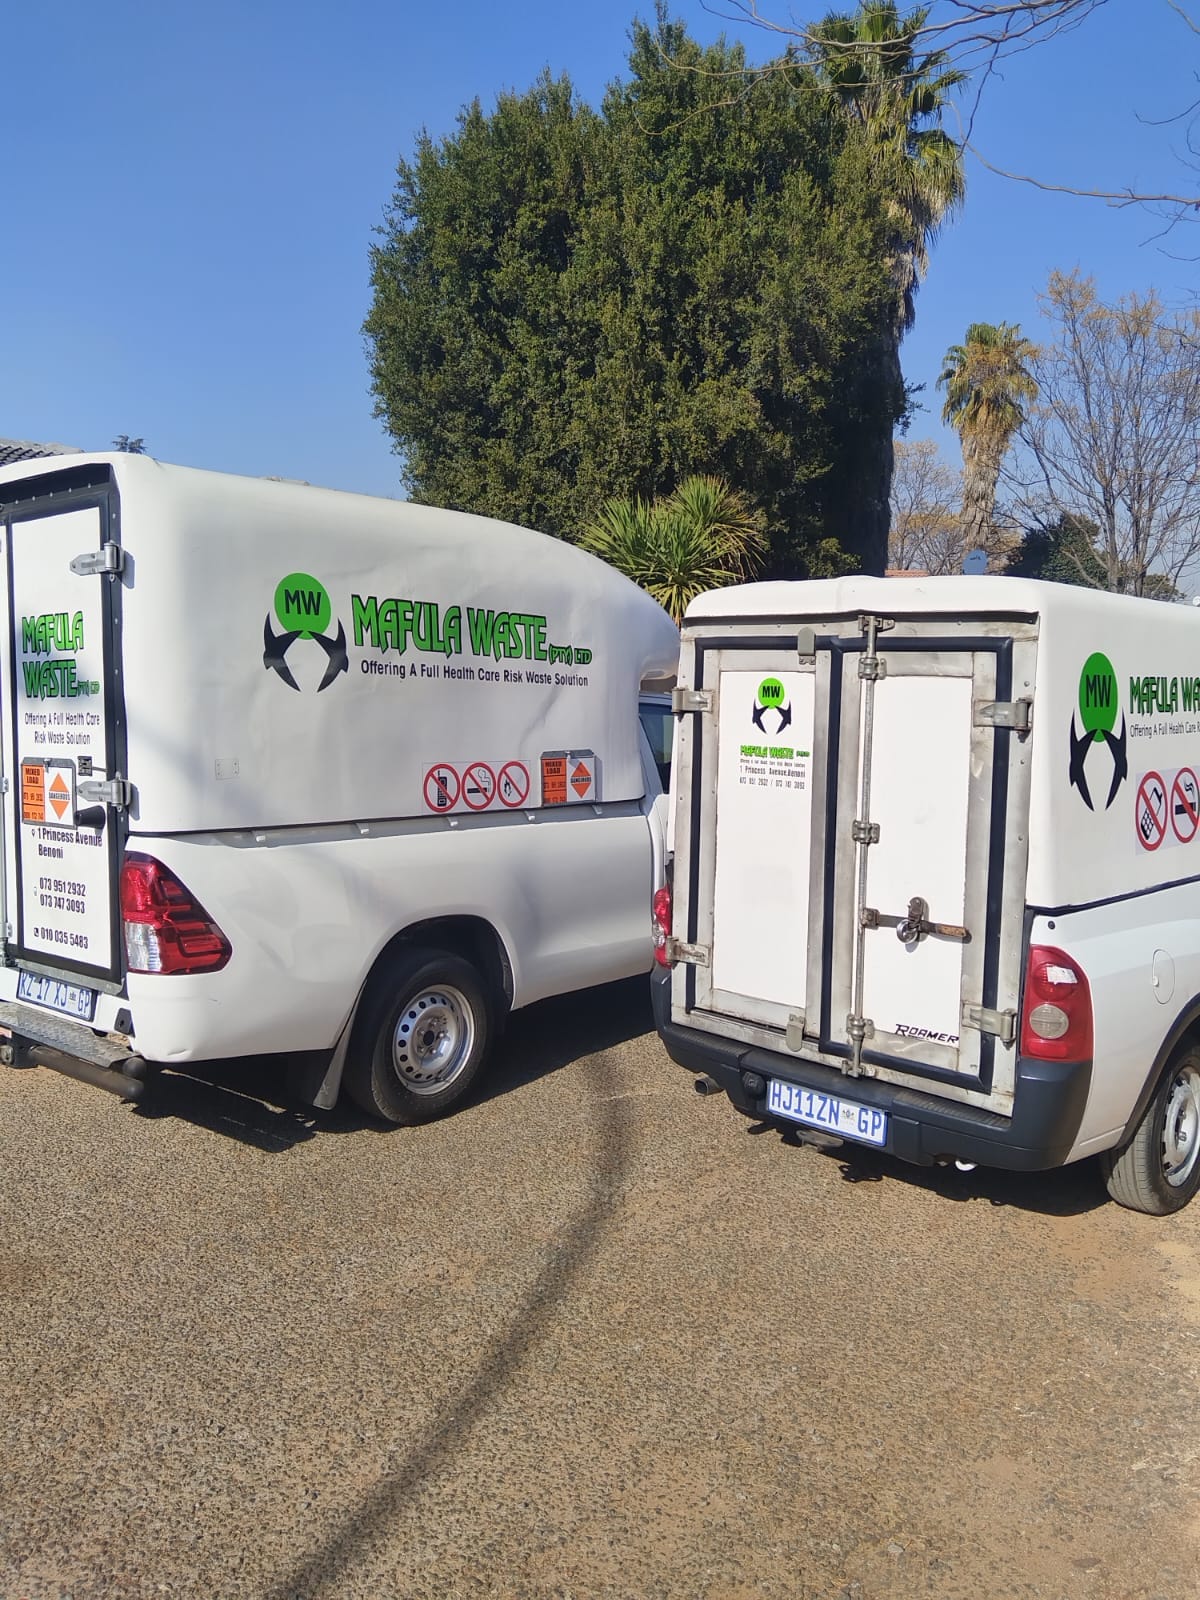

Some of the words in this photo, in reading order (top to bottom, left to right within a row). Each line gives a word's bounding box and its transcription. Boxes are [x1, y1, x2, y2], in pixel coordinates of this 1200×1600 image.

[284, 589, 321, 616] MW
[22, 611, 84, 657] MAFULA
[351, 594, 462, 659] MAFULA
[467, 607, 548, 663] WASTE
[548, 643, 573, 667] (PTY)
[574, 648, 593, 665] LTD
[22, 659, 77, 701] WASTE
[361, 660, 406, 679] Offering
[409, 663, 418, 677] A
[420, 664, 439, 678] Full
[443, 665, 475, 680] Health
[478, 668, 500, 682] Care
[503, 669, 523, 683] Risk
[525, 671, 552, 685] Waste
[554, 673, 589, 687] Solution
[762, 686, 781, 698] MW
[1085, 674, 1112, 708] MW
[1129, 676, 1178, 717] MAFULA
[25, 712, 47, 728] Offering
[48, 713, 53, 725] A
[53, 712, 64, 725] Full
[66, 712, 85, 726] Health
[86, 712, 100, 726] Care
[1130, 723, 1152, 739] Offering
[1153, 723, 1158, 736] A
[1158, 722, 1168, 736] Full
[1168, 721, 1184, 735] Health
[1185, 721, 1196, 733] Care
[34, 731, 46, 744] Risk
[48, 731, 65, 744] Waste
[66, 731, 91, 745] Solution
[25, 768, 41, 776] MIXED
[38, 827, 41, 839] 1
[42, 827, 74, 843] Princess
[75, 831, 103, 847] Avenue
[38, 843, 64, 859] Benoni
[40, 877, 52, 891] 073
[54, 879, 66, 893] 951
[67, 881, 86, 897] 2932
[40, 893, 53, 908] 073
[54, 896, 65, 910] 747
[66, 898, 85, 914] 3093
[41, 926, 53, 941] 010
[55, 930, 68, 945] 035
[69, 933, 88, 950] 5483
[20, 972, 35, 997] KZ
[37, 977, 51, 1000] 17
[54, 981, 68, 1006] XJ
[78, 988, 91, 1013] GP
[895, 1023, 960, 1044] ROAMER
[771, 1080, 840, 1126] HJ11ZN
[857, 1107, 882, 1137] GP
